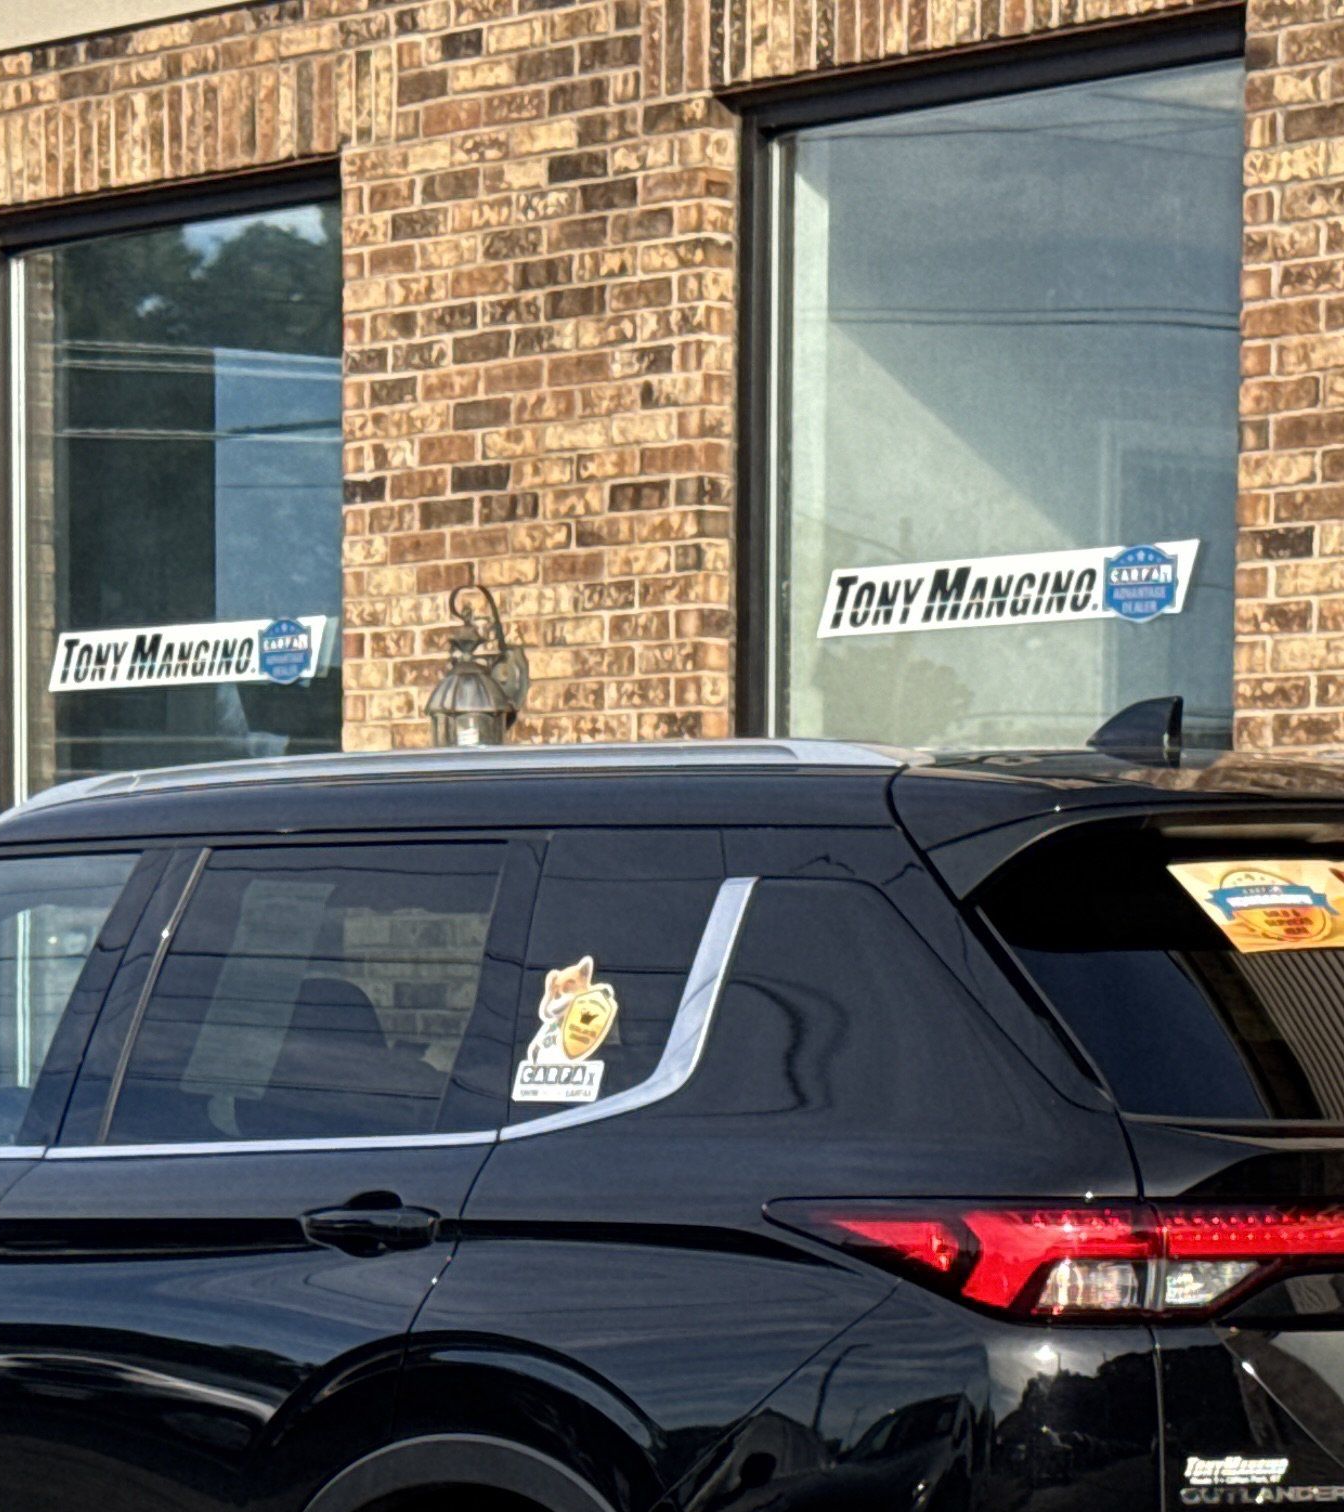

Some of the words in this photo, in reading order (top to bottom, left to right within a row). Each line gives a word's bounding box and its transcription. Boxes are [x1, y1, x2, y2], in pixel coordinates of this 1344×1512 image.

[830, 575, 924, 629] TONY
[60, 639, 128, 684] TONY
[519, 1065, 595, 1086] CARFAX
